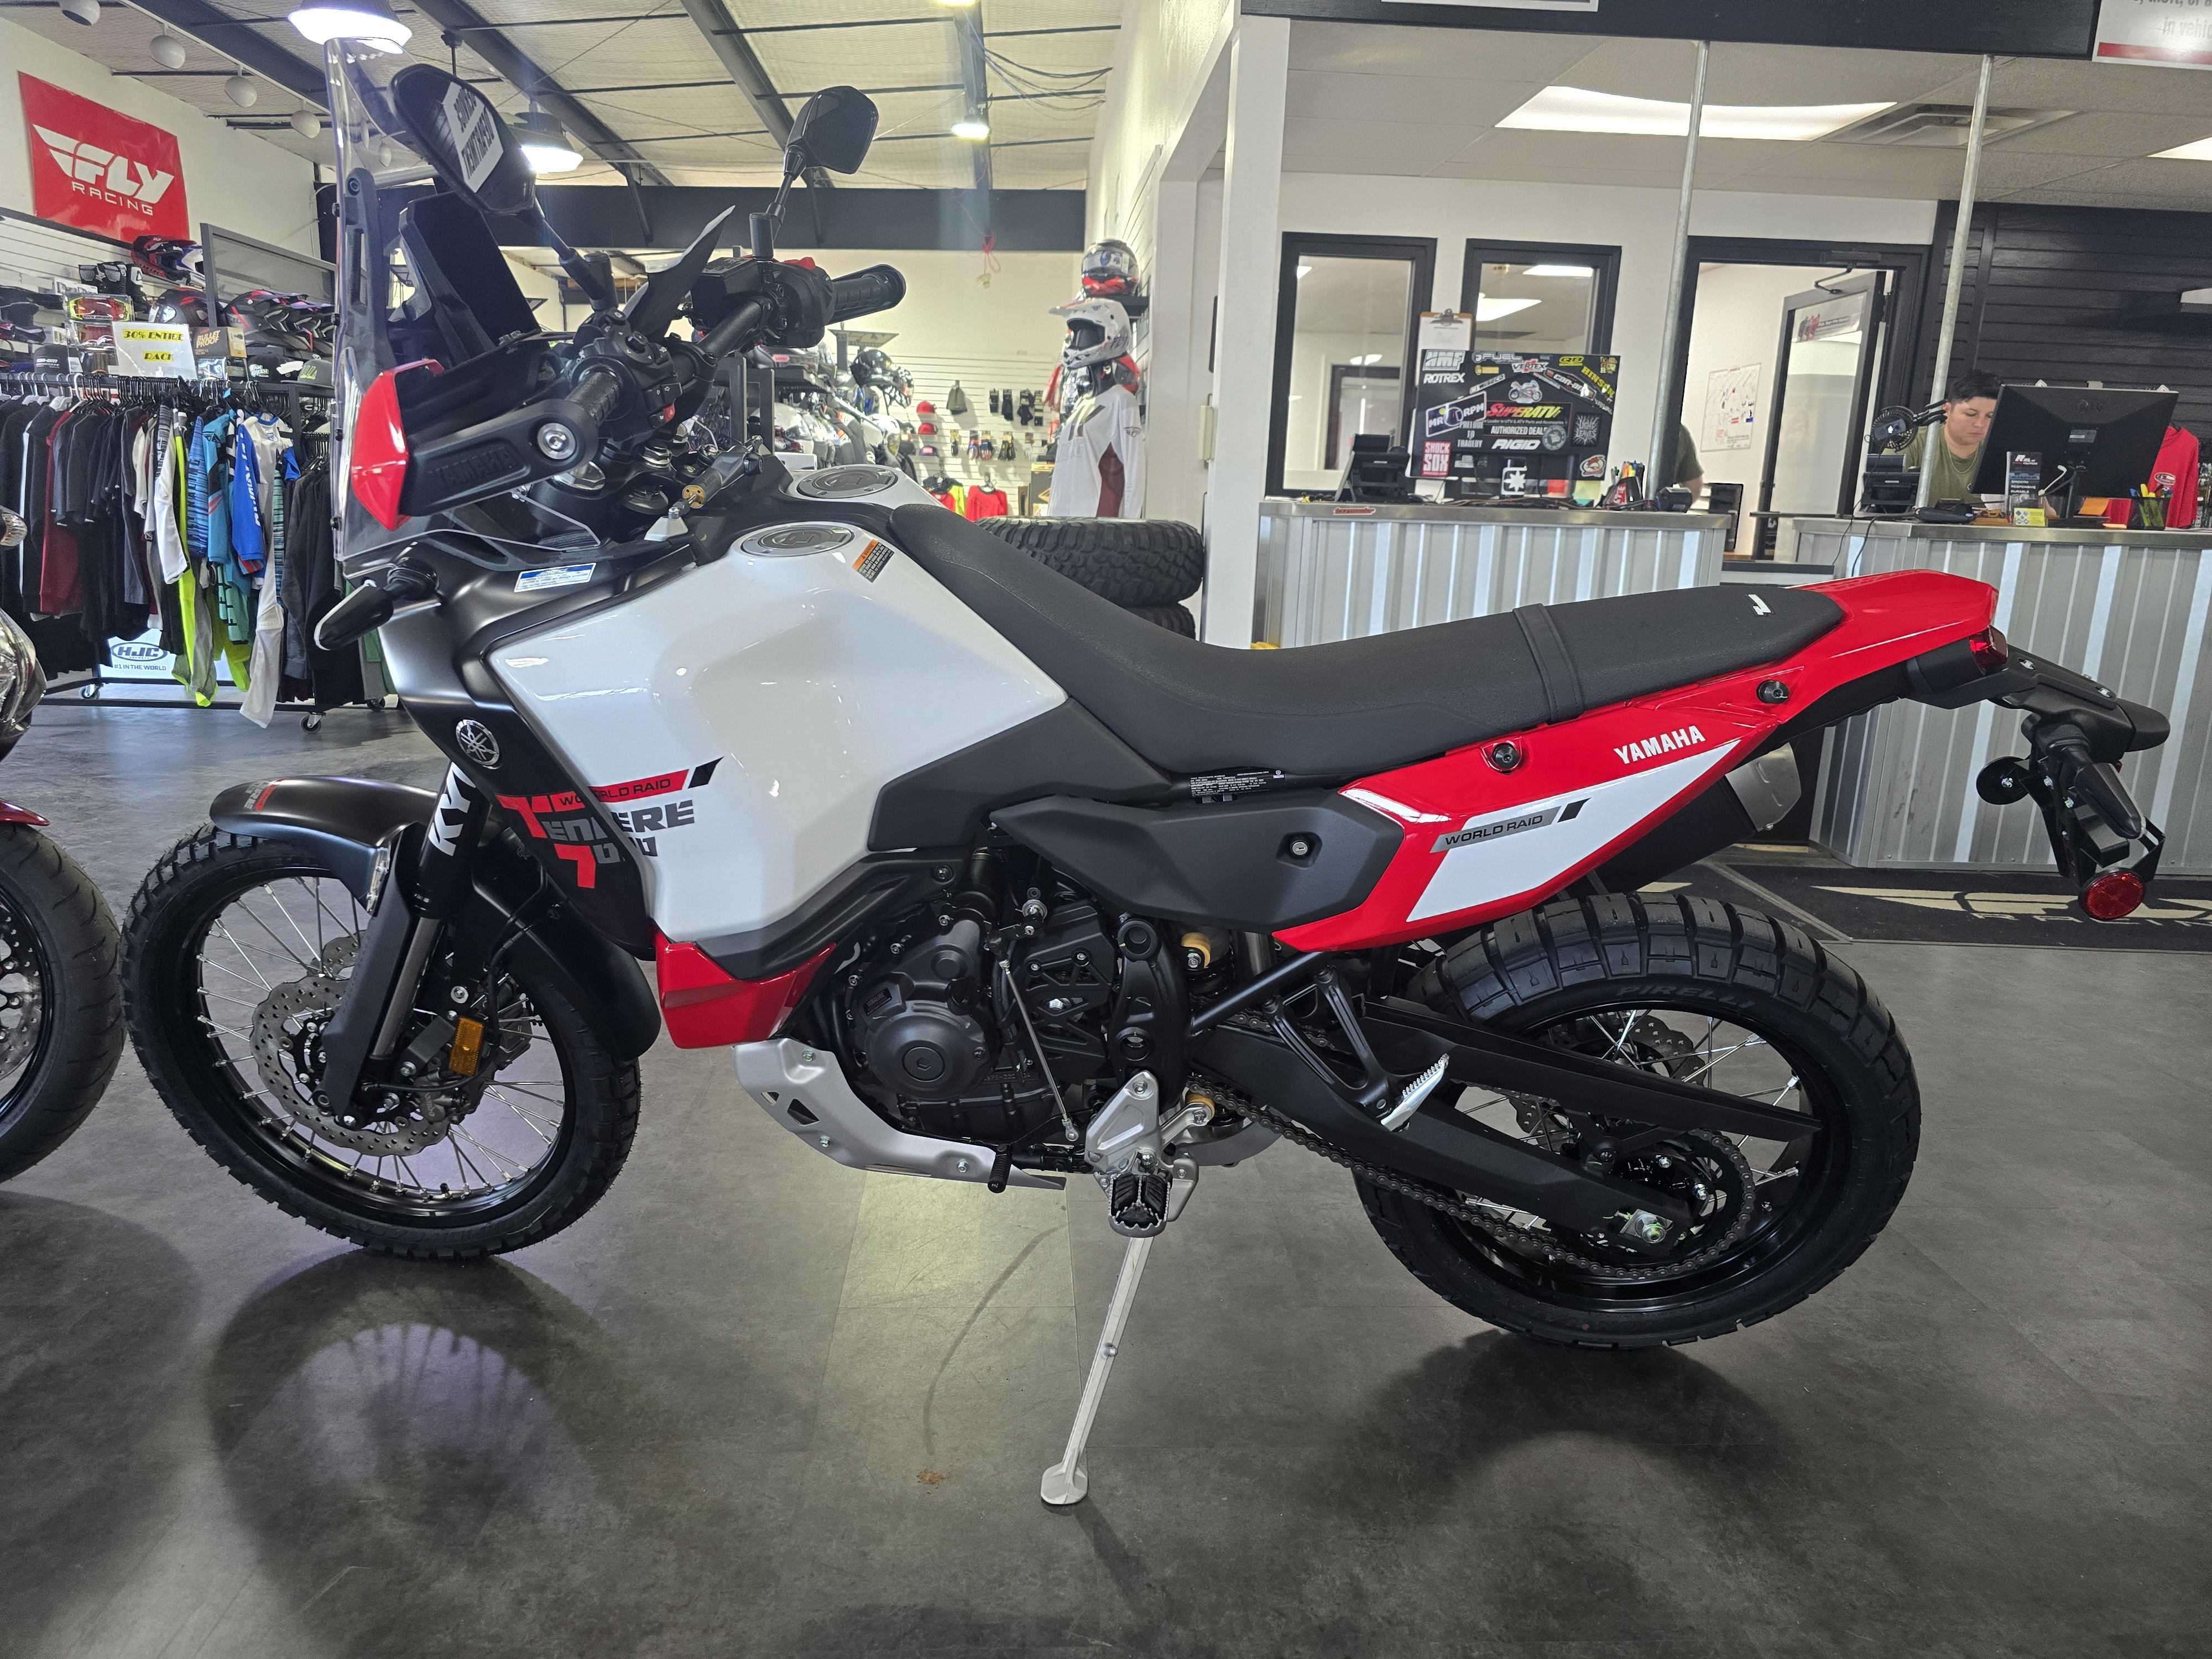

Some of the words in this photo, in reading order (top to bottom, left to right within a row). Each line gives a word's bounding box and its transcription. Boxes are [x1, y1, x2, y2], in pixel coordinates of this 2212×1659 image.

[33, 124, 175, 204] FLY
[71, 181, 153, 216] RACING
[148, 332, 184, 341] ENTIRE
[196, 337, 219, 349] PROOF
[197, 330, 221, 341] BULLET
[1425, 352, 1464, 367] HMF
[1423, 373, 1465, 383] ROTREX
[1428, 417, 1443, 427] MR
[1463, 403, 1484, 416] RPM
[1491, 426, 1527, 434] AUTHORIZED
[1425, 443, 1449, 453] SHOCK
[1492, 439, 1541, 450] RIGID
[1423, 454, 1449, 472] SOX
[117, 646, 160, 658] HJC
[1614, 725, 1705, 765] YAMAHA
[560, 786, 630, 806] WORLD
[632, 778, 671, 795] RAID
[1445, 825, 1504, 845] WORLD
[1506, 815, 1543, 832] RAID
[1616, 985, 1756, 1009] PIRELLI
